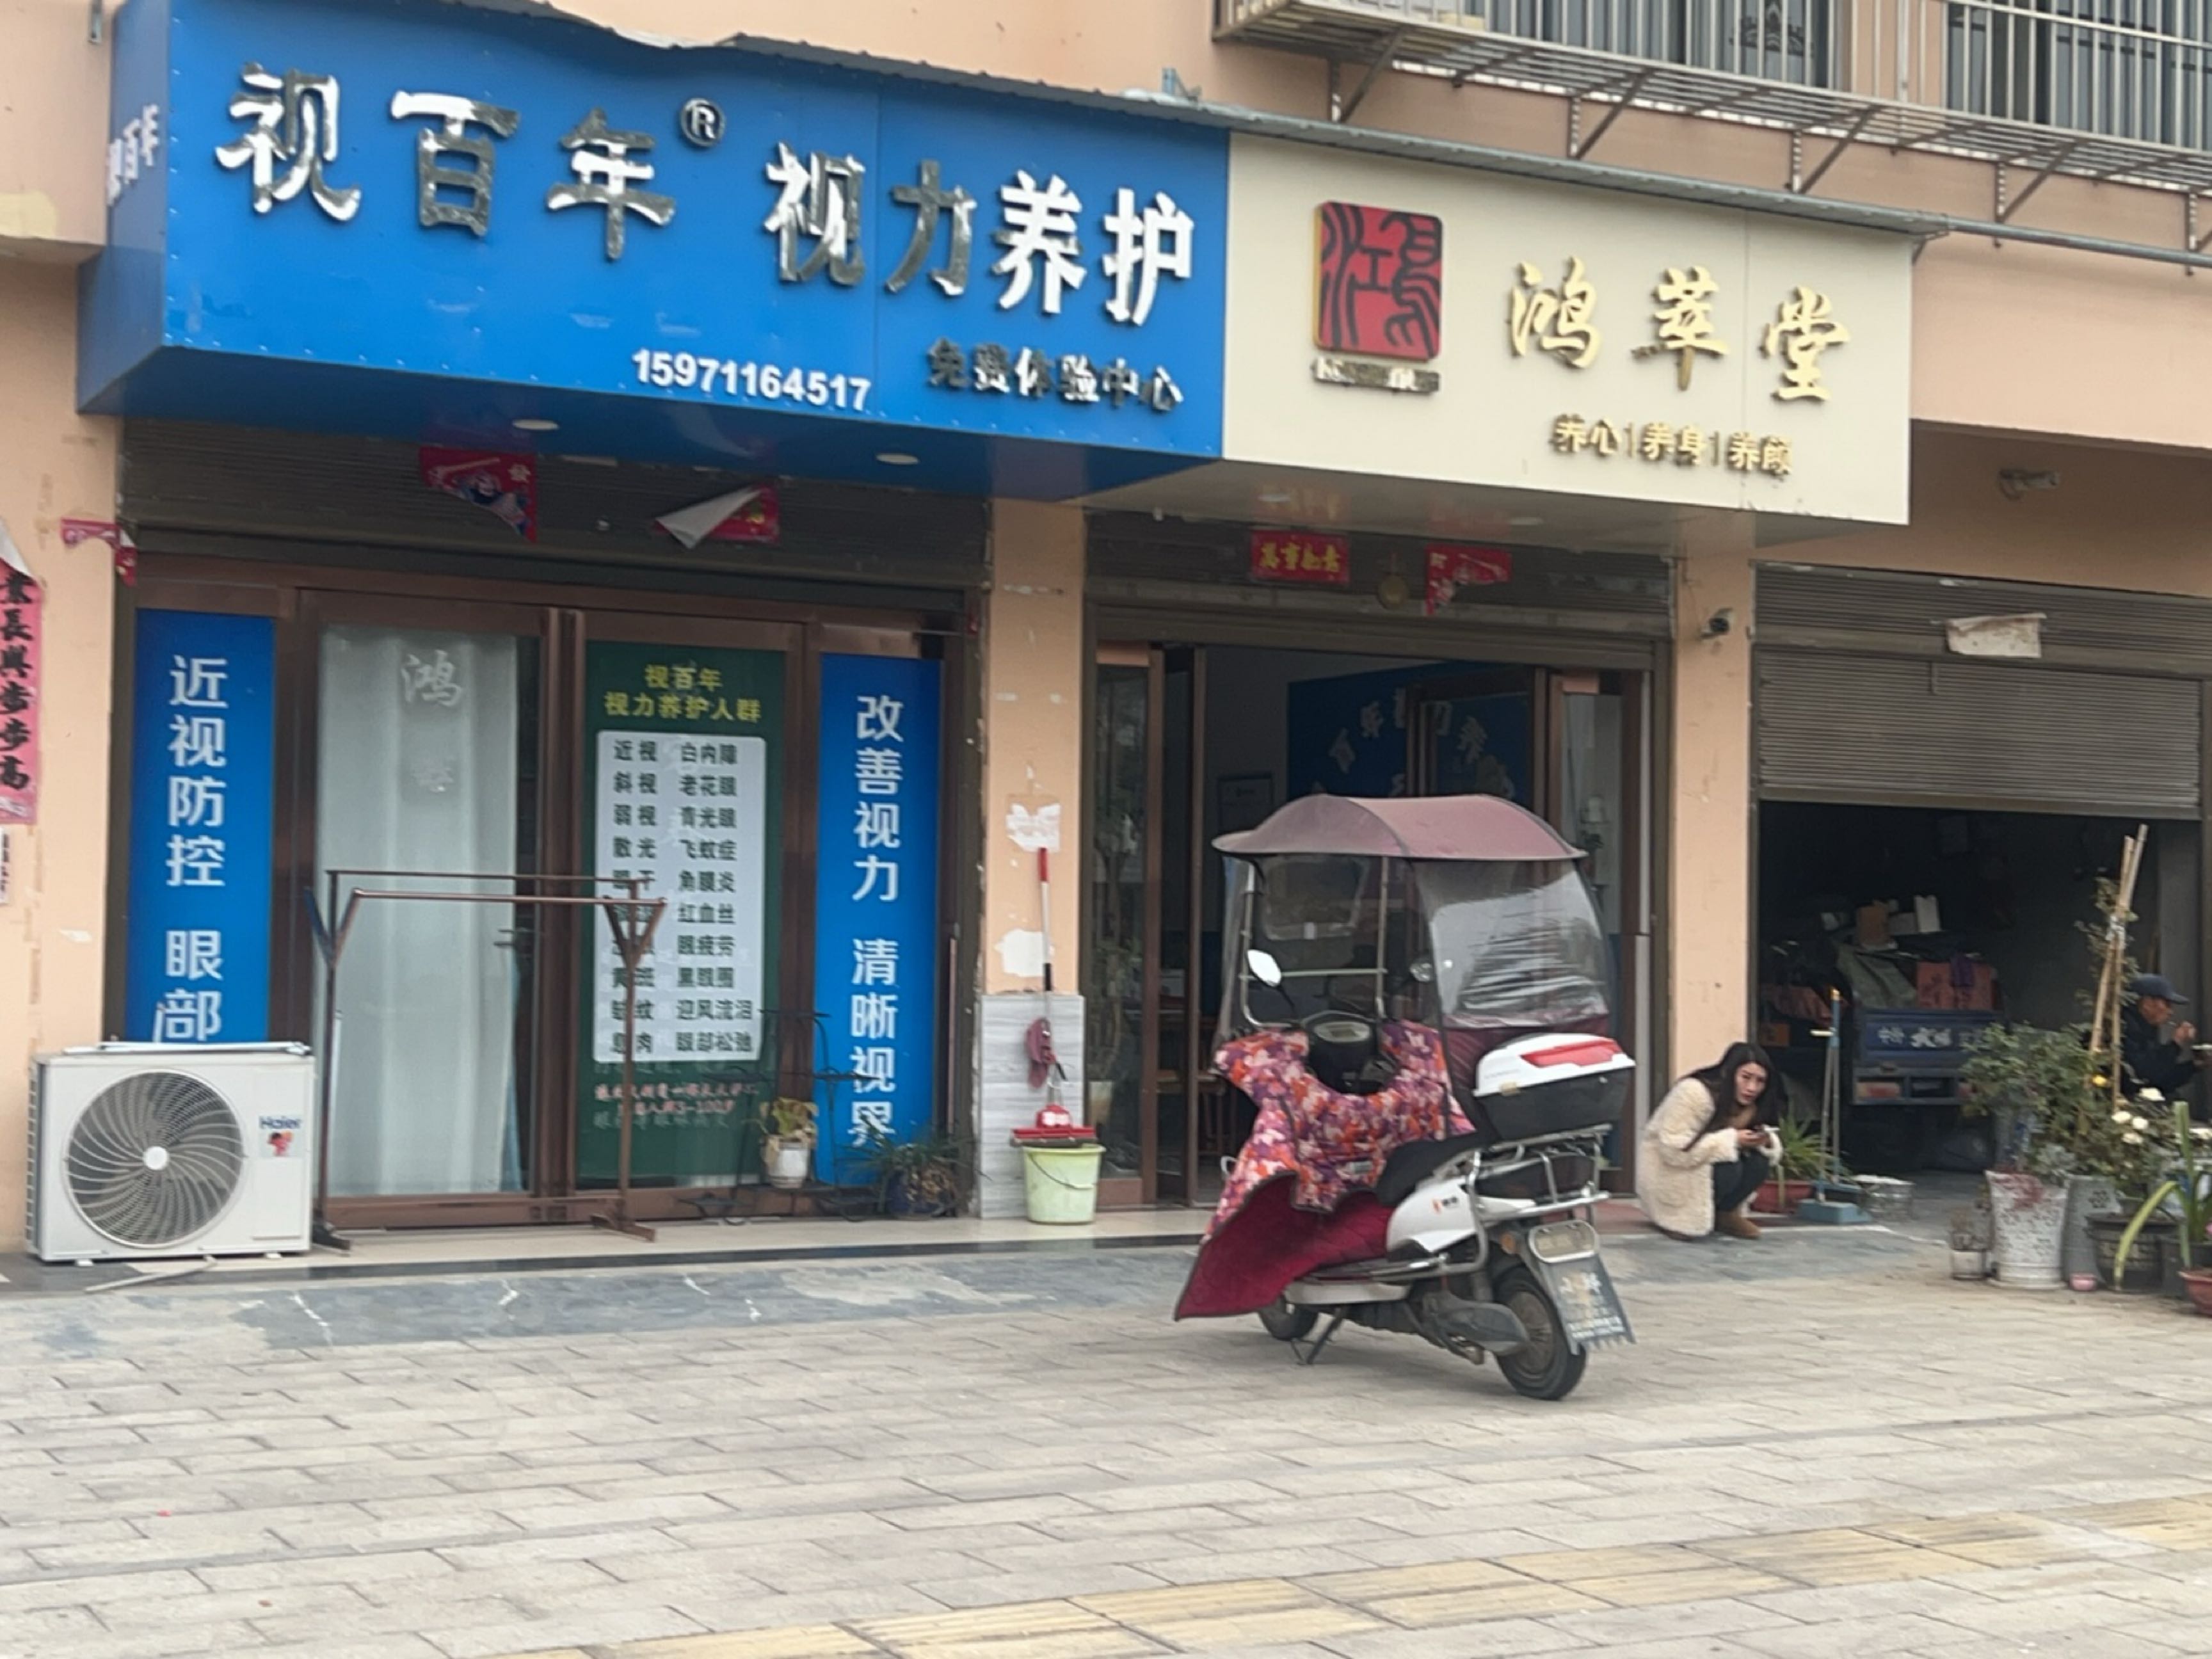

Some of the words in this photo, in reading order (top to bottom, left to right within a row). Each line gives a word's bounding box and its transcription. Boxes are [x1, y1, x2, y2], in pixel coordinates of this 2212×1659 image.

[765, 141, 1194, 326] 视力养护
[1507, 257, 1850, 402] 鸿萃堂
[632, 348, 871, 412] 15971164517
[927, 337, 1184, 413] 免费体验中心
[645, 664, 722, 691] 视百年
[605, 691, 761, 723] 视力养护人群
[613, 740, 657, 762] 近视
[166, 655, 229, 886] 近视防控
[613, 771, 657, 794] 斜视
[679, 774, 737, 797] 老花眼
[852, 696, 904, 902] 改善视力
[679, 806, 737, 828] 青光眼
[613, 836, 657, 858] 散光
[679, 839, 737, 860] 飞蚊症
[678, 870, 735, 892] 角膜炎
[678, 903, 735, 924] 红血丝
[677, 935, 734, 956] 眼疲劳
[677, 967, 733, 988] 黑眼圈
[677, 999, 752, 1020] 迎风流泪
[676, 1032, 753, 1052] 眼部松弛
